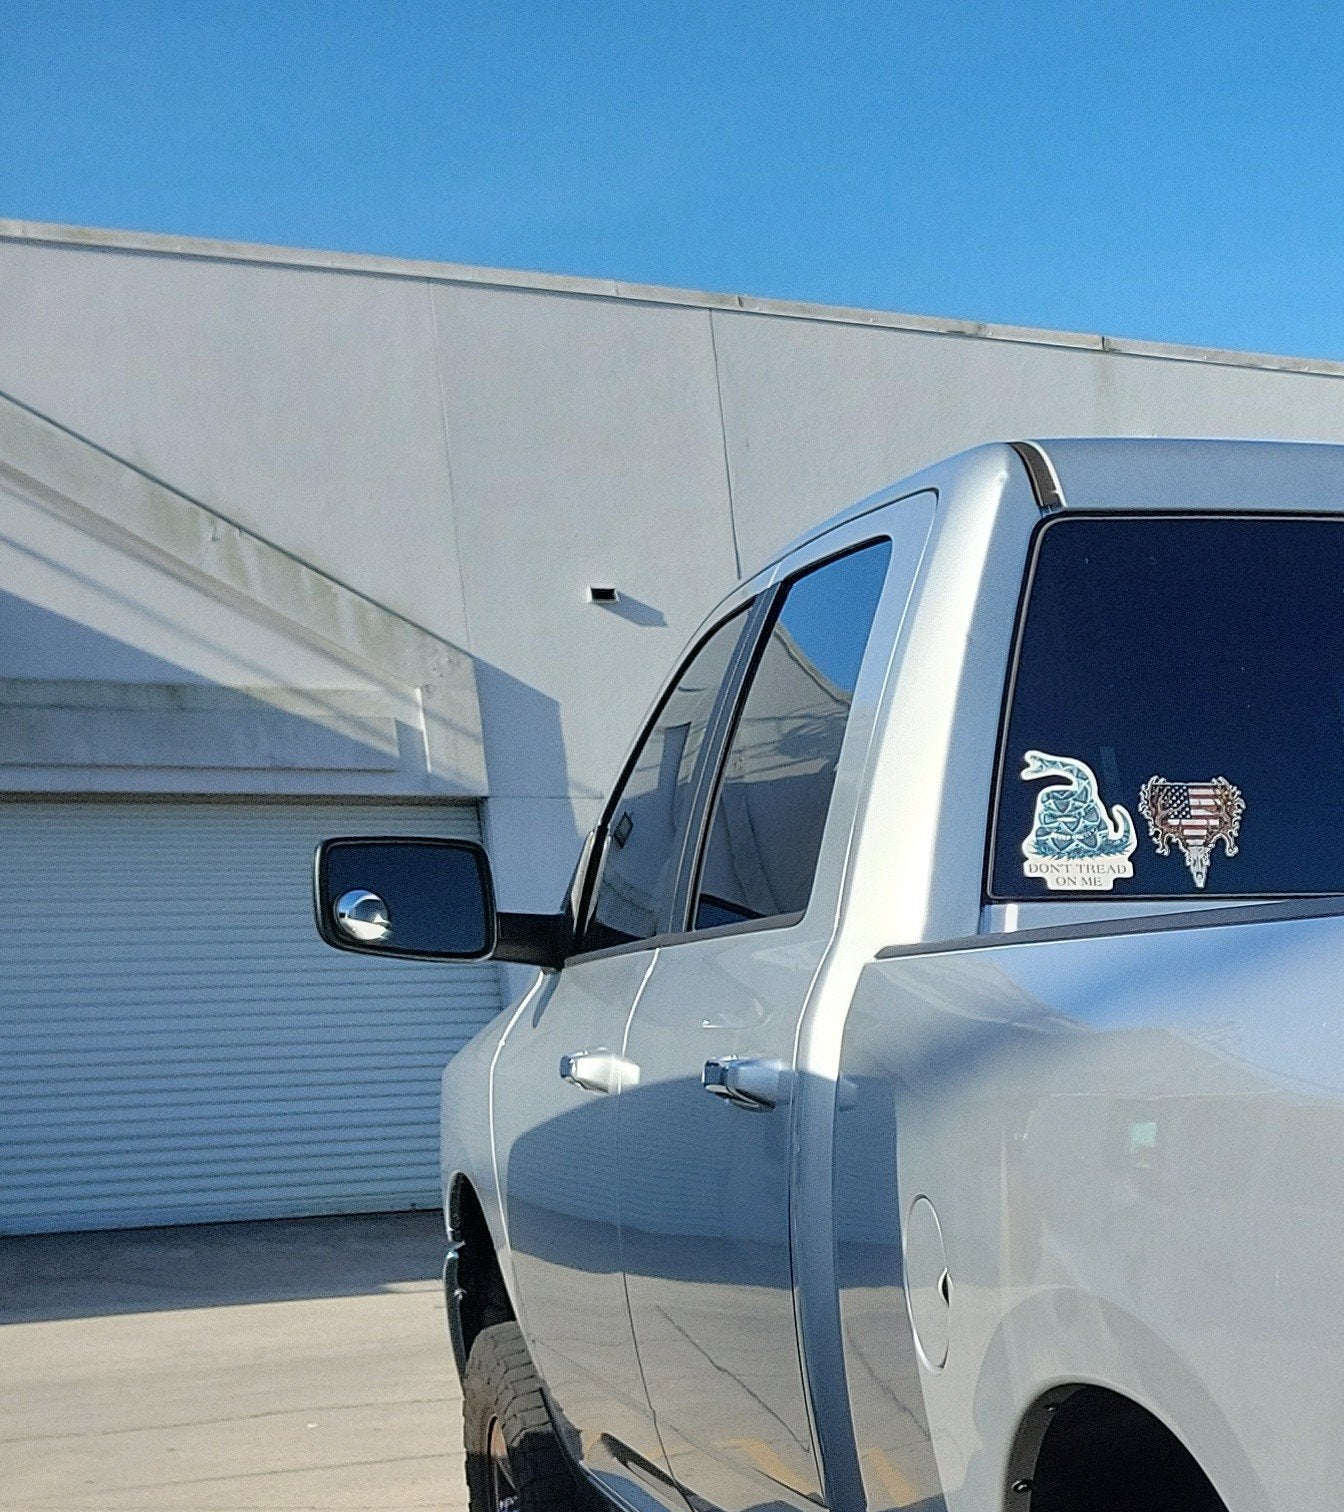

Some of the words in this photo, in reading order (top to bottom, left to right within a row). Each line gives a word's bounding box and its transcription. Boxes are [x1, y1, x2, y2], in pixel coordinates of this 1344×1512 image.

[1029, 864, 1071, 873] DON'T
[1076, 864, 1127, 874] TREAD
[1056, 876, 1077, 886] ON
[1081, 877, 1103, 886] ME
